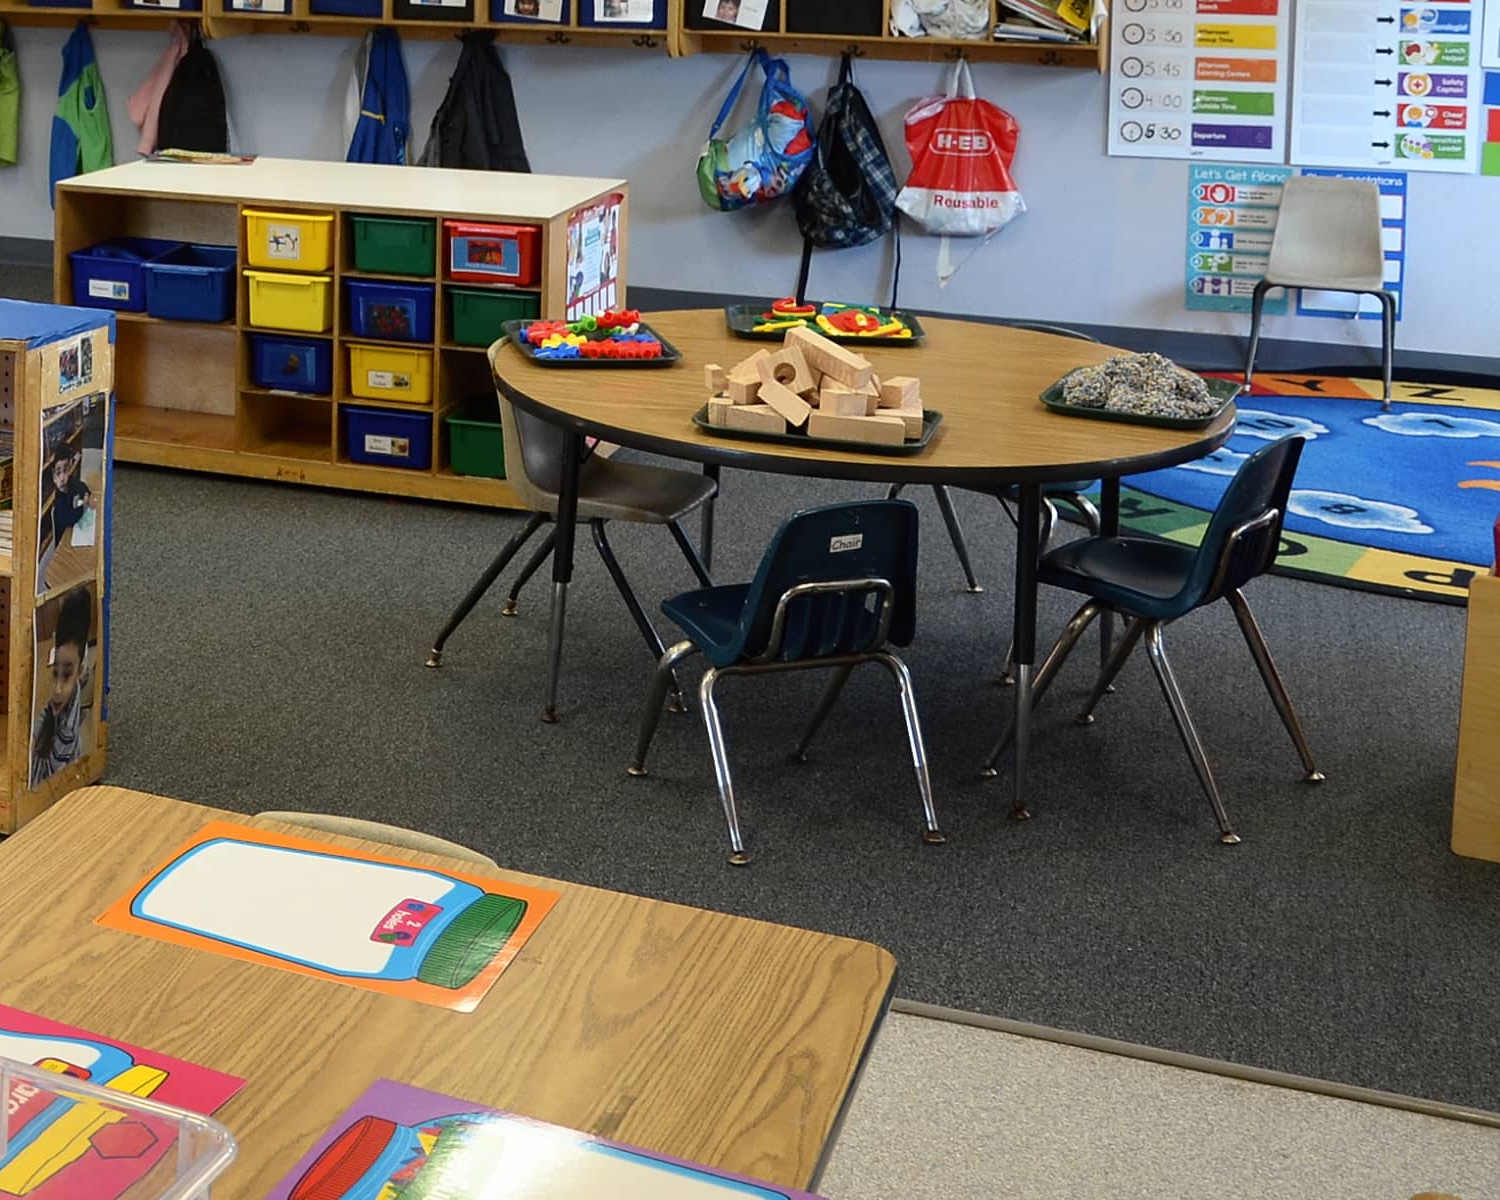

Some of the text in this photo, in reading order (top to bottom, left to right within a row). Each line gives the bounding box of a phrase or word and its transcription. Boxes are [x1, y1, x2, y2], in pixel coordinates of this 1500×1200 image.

[1193, 132, 1227, 140] Departure
[1225, 170, 1247, 181] Get
[933, 195, 1000, 210] Reusable
[832, 539, 861, 550] Chair
[383, 910, 412, 929] holes
[406, 920, 422, 928] 2
